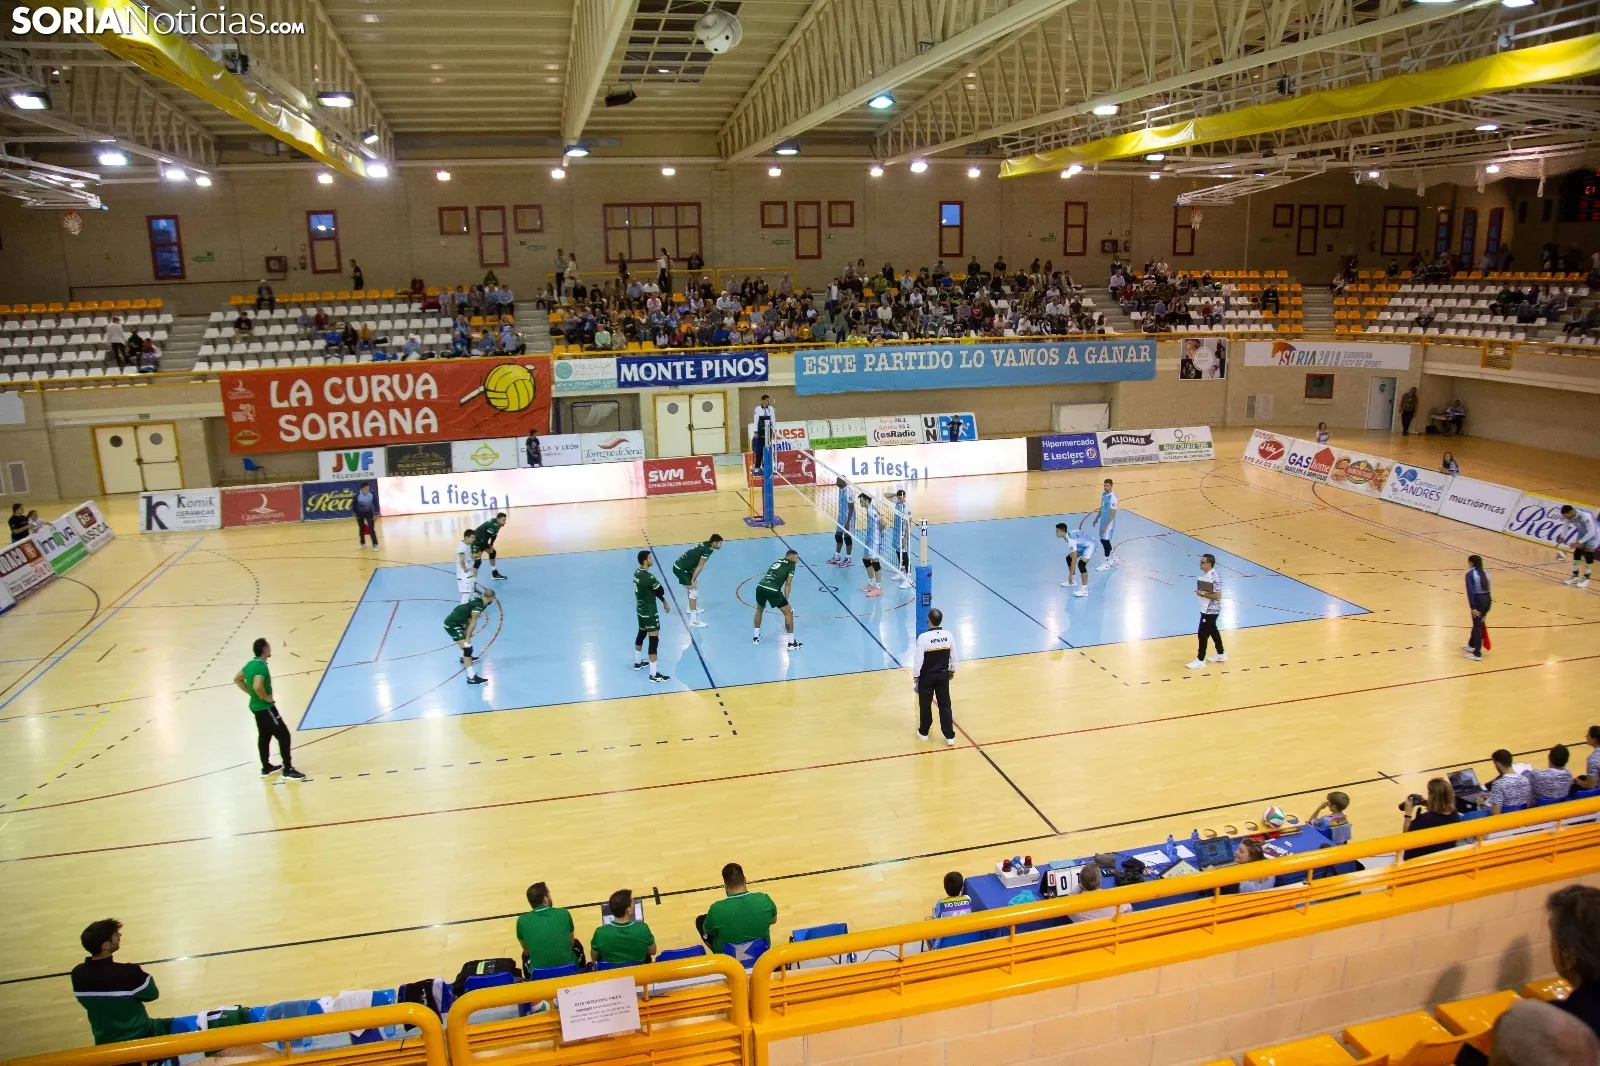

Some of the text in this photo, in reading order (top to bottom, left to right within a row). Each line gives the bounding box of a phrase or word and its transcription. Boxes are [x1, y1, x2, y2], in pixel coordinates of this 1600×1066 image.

[803, 345, 1151, 375] ESTE PARTIDO LO VAMOS A GANAR
[1344, 351, 1373, 359] EUROPEAN
[620, 357, 766, 382] MONTE PINOS
[270, 372, 438, 408] LA CURVA
[279, 406, 438, 442] SORIANA
[1042, 438, 1095, 449] Hipermercado
[1111, 436, 1146, 445] ALJOMAR
[332, 451, 374, 472] JVF
[852, 457, 869, 475] La
[1288, 453, 1312, 468] GAS
[1311, 459, 1331, 472] home
[648, 468, 684, 482] SVM
[1415, 478, 1445, 491] Comercial
[306, 492, 353, 512] Rea
[421, 485, 440, 504] La
[1049, 873, 1055, 885] 0
[1060, 875, 1067, 890] 0
